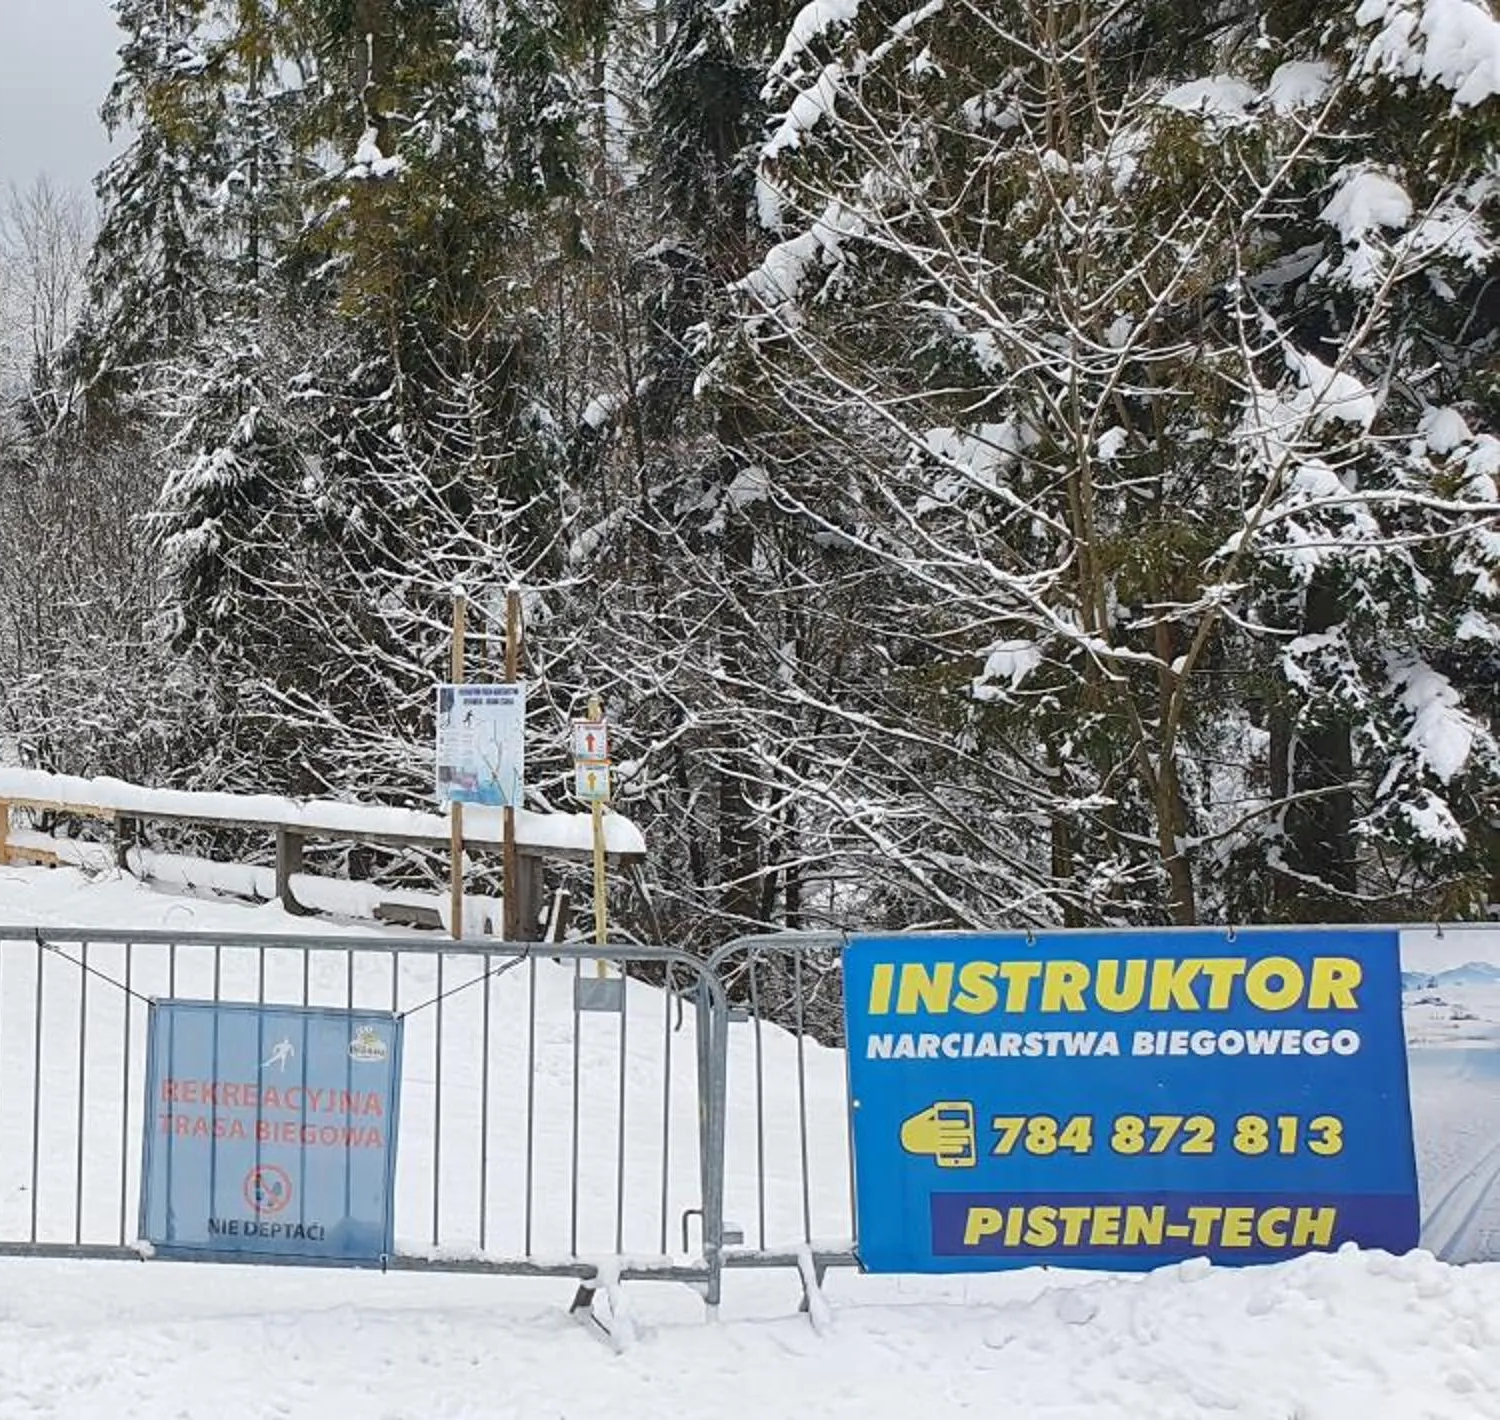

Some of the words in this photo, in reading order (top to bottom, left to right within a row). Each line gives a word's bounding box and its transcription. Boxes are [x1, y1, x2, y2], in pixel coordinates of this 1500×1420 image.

[867, 955, 1363, 1015] INSTRUKTOR
[866, 1030, 1121, 1060] NARCIARSTWA
[1131, 1028, 1361, 1057] BIEGOWEGO
[161, 1078, 384, 1119] REKREACYJNA
[158, 1113, 247, 1140] TRASA
[256, 1119, 383, 1149] BIEGOWA
[991, 1114, 1094, 1155] 784
[1110, 1114, 1216, 1155] 872
[1233, 1114, 1345, 1156] 813
[207, 1218, 240, 1237] NIE
[243, 1219, 326, 1241] DEPTAĆ!
[962, 1205, 1338, 1248] PISTEN-TECH
